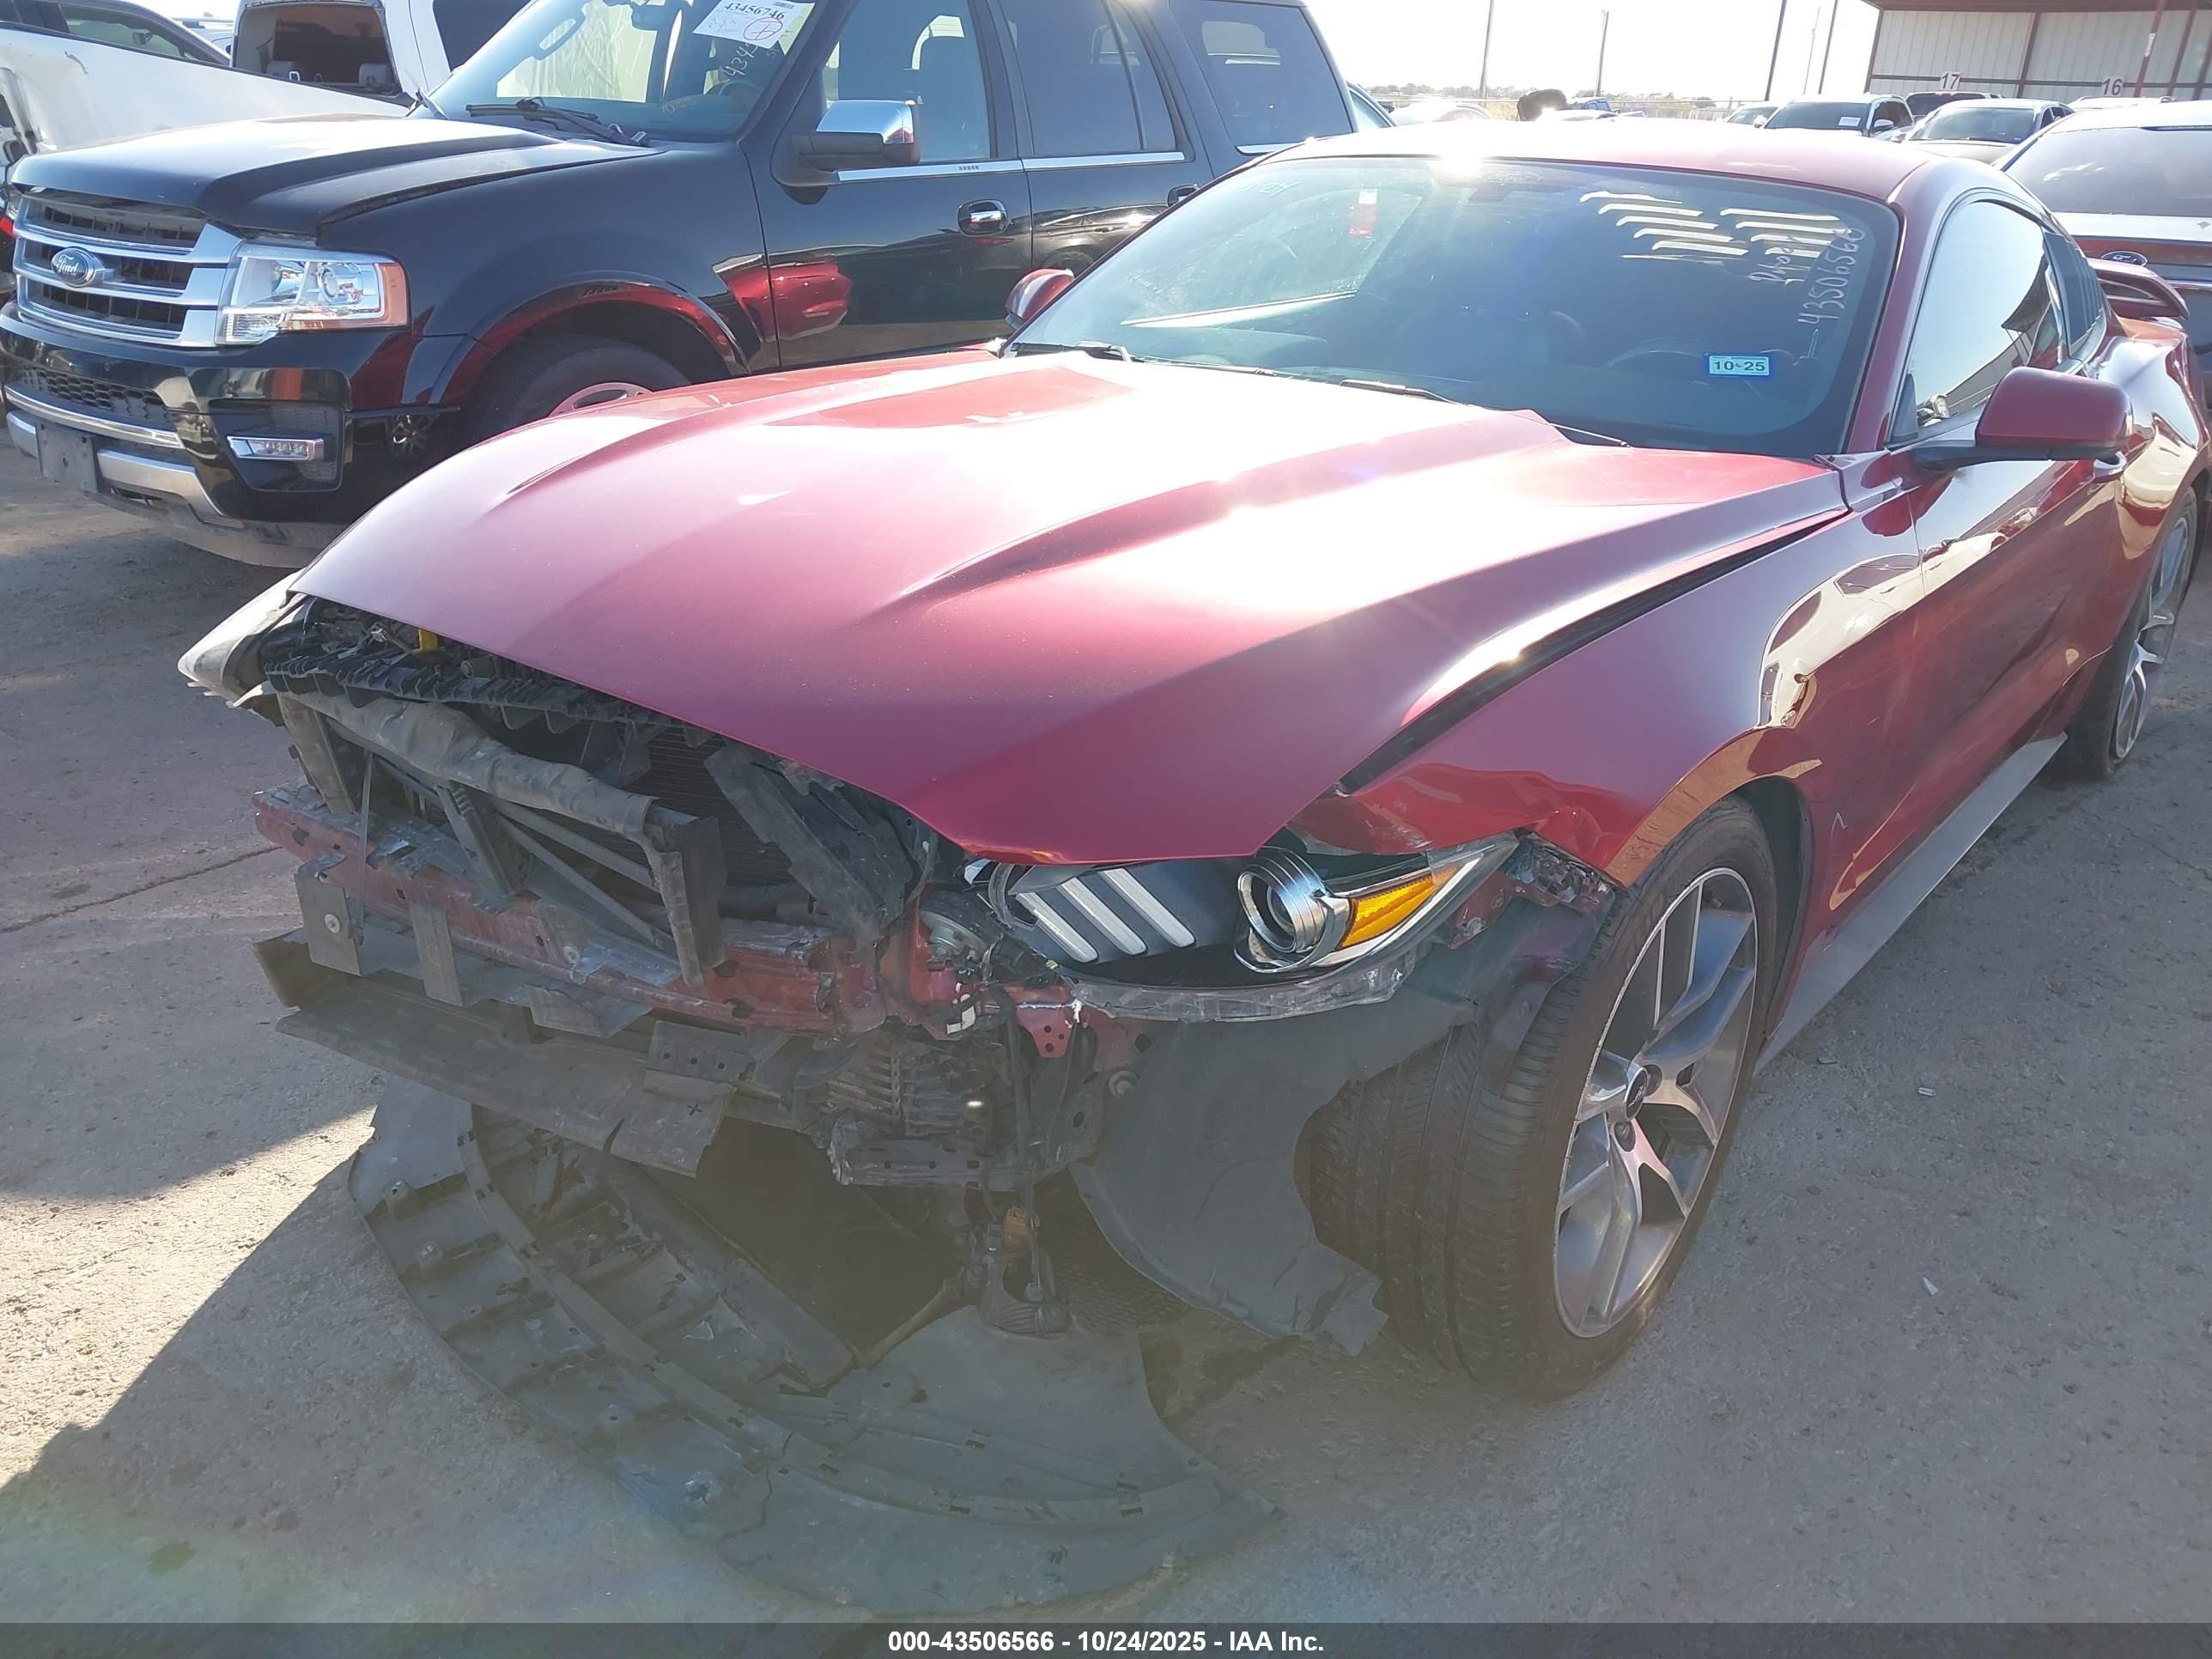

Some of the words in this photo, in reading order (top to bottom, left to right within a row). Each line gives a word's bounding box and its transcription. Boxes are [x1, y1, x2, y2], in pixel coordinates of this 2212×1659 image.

[724, 3, 786, 20] 43456746
[1941, 72, 1960, 90] 17
[2102, 78, 2124, 95] 16
[56, 254, 80, 276] Ford
